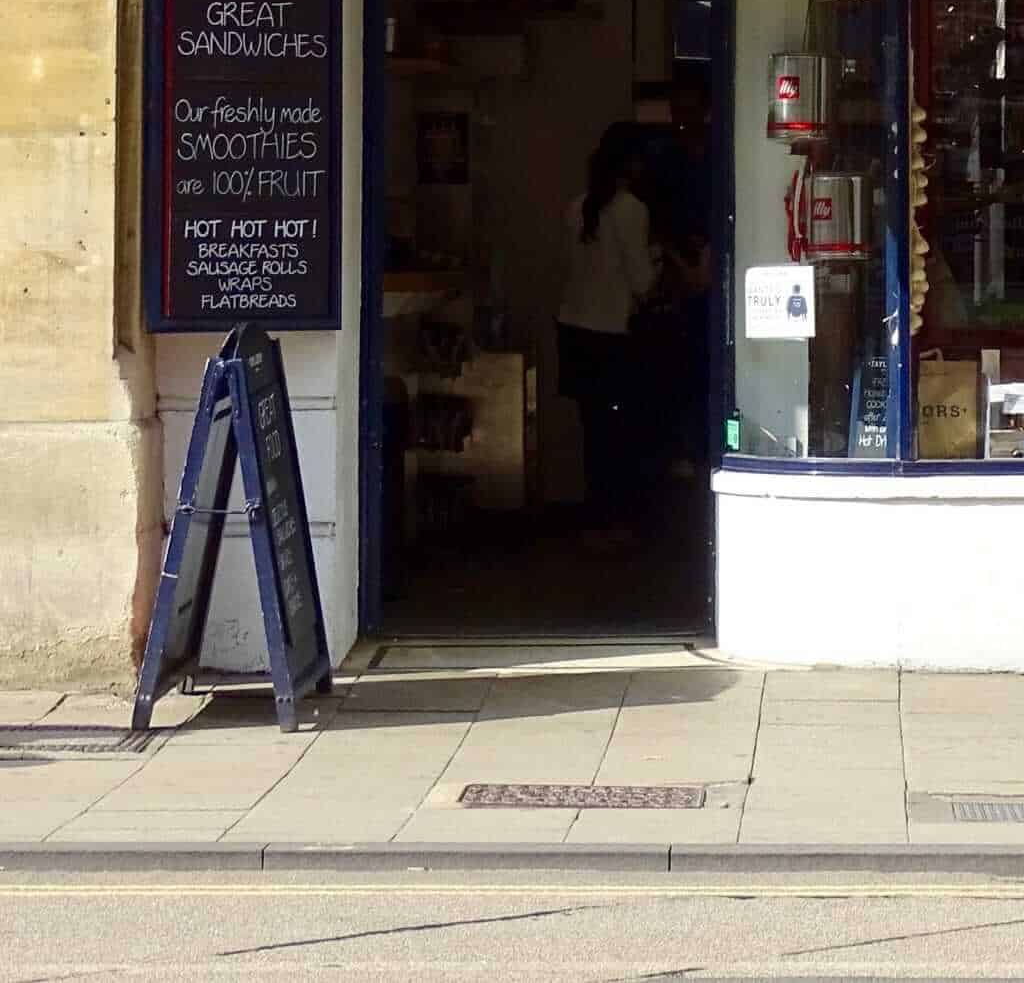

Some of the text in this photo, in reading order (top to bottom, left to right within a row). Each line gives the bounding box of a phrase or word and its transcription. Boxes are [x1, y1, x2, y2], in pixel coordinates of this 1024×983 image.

[206, 2, 293, 27] GREAT
[177, 31, 327, 58] SANDWICHES
[175, 96, 322, 133] Our freshly made
[177, 132, 318, 161] SMOOTHIES
[176, 167, 327, 202] are 100% FRUIT
[184, 220, 222, 239] HOT
[230, 220, 268, 239] HOT
[198, 243, 299, 259] BREAKFASTS
[186, 260, 308, 276] SAUSAGE ROLLS
[218, 277, 273, 292] WRAPS
[201, 294, 297, 309] FLATBREADS
[747, 296, 782, 307] TRULY
